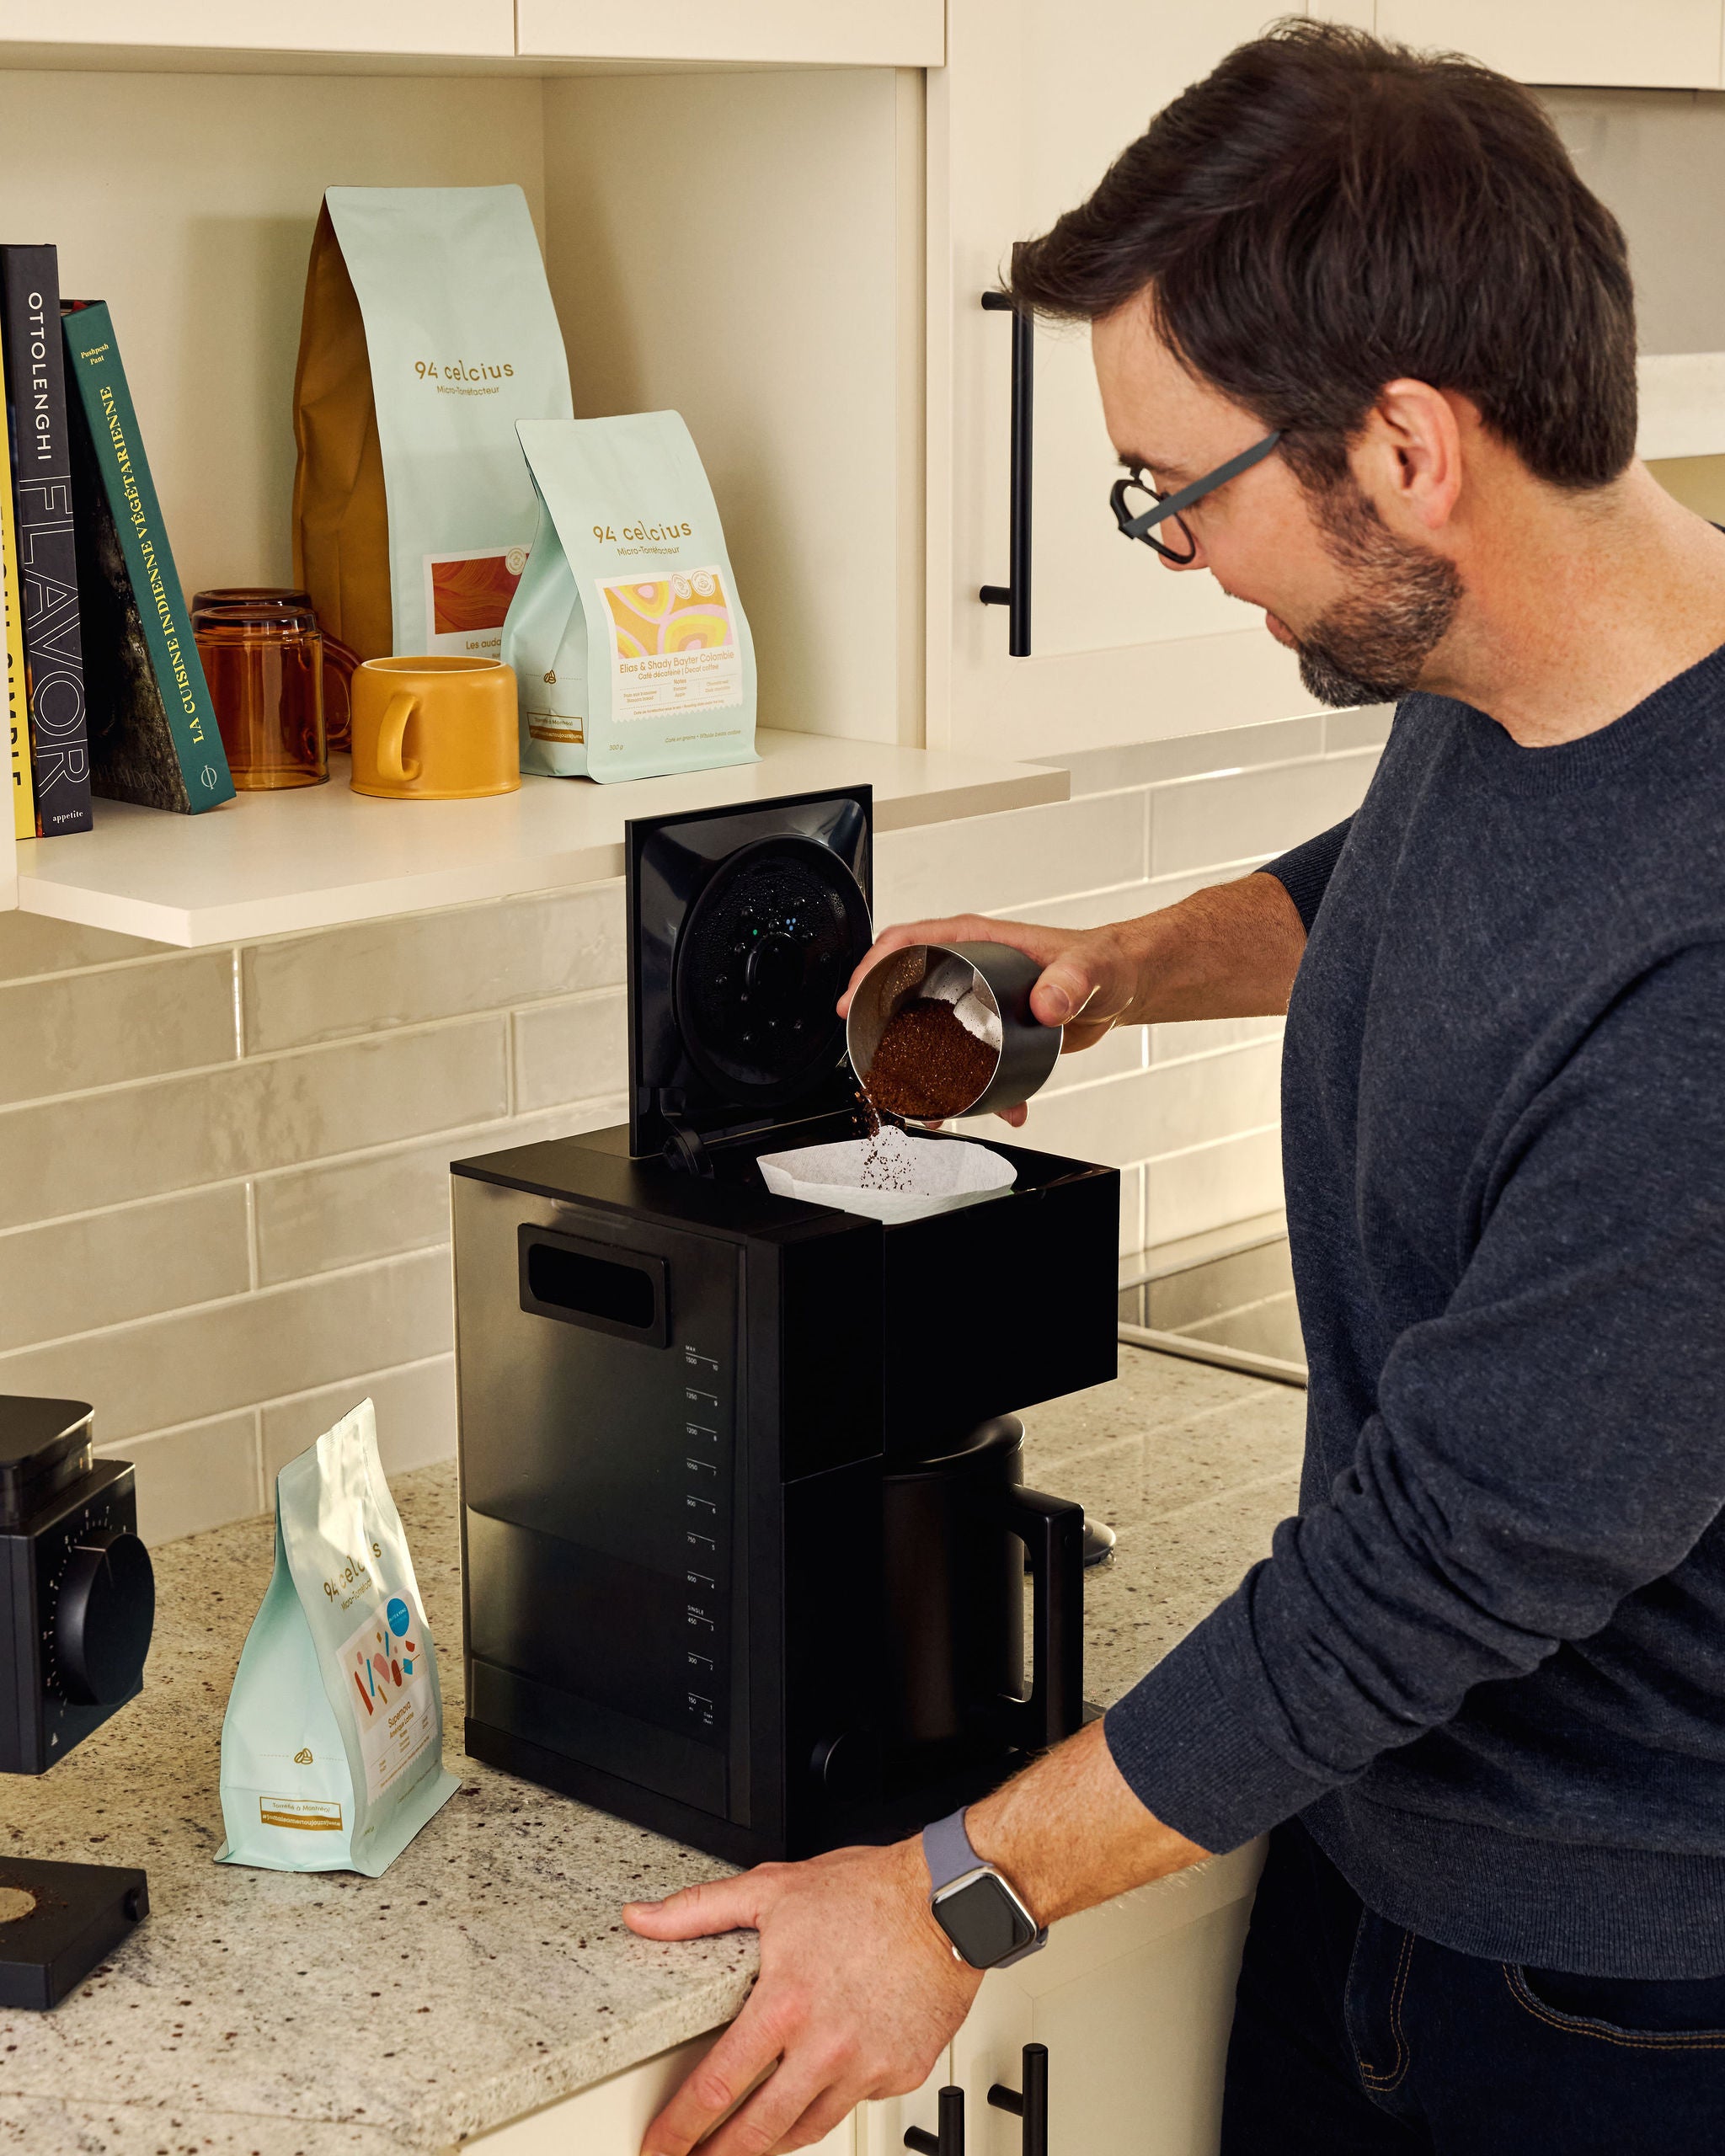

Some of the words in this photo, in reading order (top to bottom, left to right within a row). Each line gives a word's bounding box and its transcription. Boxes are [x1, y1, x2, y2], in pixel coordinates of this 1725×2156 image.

[80, 343, 109, 360] Pushpesh
[90, 355, 104, 366] Pant
[28, 291, 51, 461] OTTOLENGHI
[414, 360, 438, 380] 94
[444, 360, 515, 382] celcius
[99, 386, 148, 539] VÉGÉTARIENNE
[592, 526, 617, 544] 94
[622, 520, 692, 542] celcius
[141, 540, 175, 636] INDIENNE
[19, 475, 90, 798] FLAVOR
[466, 640, 479, 650] Les
[619, 663, 638, 674] Elias
[640, 661, 646, 671] &
[648, 659, 672, 670] Shady
[673, 656, 698, 667] Bayter
[700, 650, 734, 663] Colombie
[167, 638, 196, 714] CUISINE
[189, 717, 205, 744] LA
[52, 809, 83, 824] appetite
[686, 1535, 697, 1545] 750
[339, 1542, 382, 1589] celcs
[687, 1604, 705, 1616] SINGLE
[687, 1617, 697, 1625] 450
[687, 1656, 697, 1665] 300
[688, 1695, 697, 1705] 150
